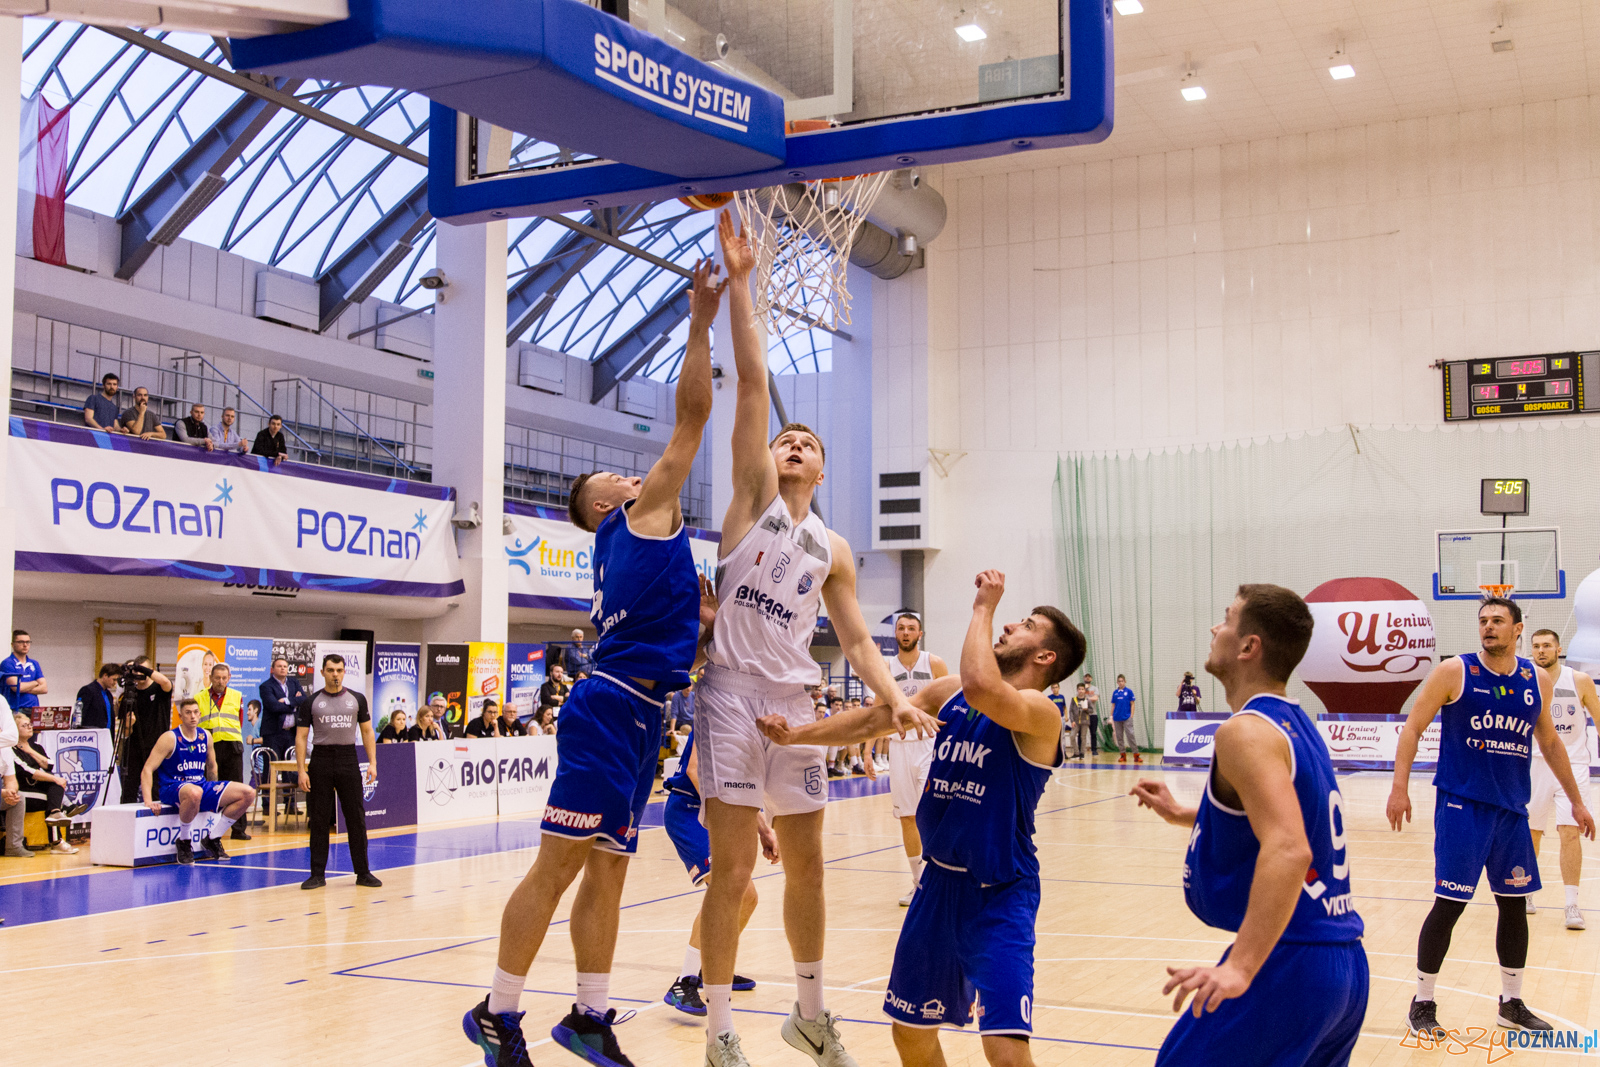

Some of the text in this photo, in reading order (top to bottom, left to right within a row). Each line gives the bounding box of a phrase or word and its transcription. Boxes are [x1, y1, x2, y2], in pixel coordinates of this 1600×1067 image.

[594, 33, 751, 122] SPORT SYSTEM
[1555, 359, 1562, 369] 4
[1480, 381, 1570, 399] 47 4 71
[1476, 402, 1569, 414] GOŚCIE GOSPODARZE
[1494, 481, 1523, 494] 5:05
[541, 567, 572, 578] biuro
[771, 551, 791, 583] 5
[733, 600, 756, 609] POLSKI
[1337, 611, 1382, 655] U
[435, 654, 460, 663] drukma
[469, 656, 502, 664] Słoneczna
[378, 657, 417, 676] SELENKA
[511, 663, 534, 673] MOCNE
[511, 674, 526, 682] STAWY
[529, 673, 543, 681] KOŚCI
[1523, 688, 1534, 706] 6
[1347, 725, 1378, 733] leniwej
[1470, 709, 1532, 738] GÓRNIK
[1182, 733, 1214, 744] atrem
[1328, 724, 1345, 741] U
[1346, 732, 1381, 742] Danuty
[59, 735, 95, 743] BIOFARM
[197, 743, 207, 753] 13
[1485, 739, 1529, 754] TRANS.EU
[177, 759, 206, 771] GÓRNIK
[461, 756, 549, 786] BIOFARM
[724, 781, 756, 790] macron
[804, 765, 822, 795] 5
[525, 785, 543, 794] LEKÓW
[1328, 790, 1350, 881] 9
[1020, 995, 1031, 1024] 0
